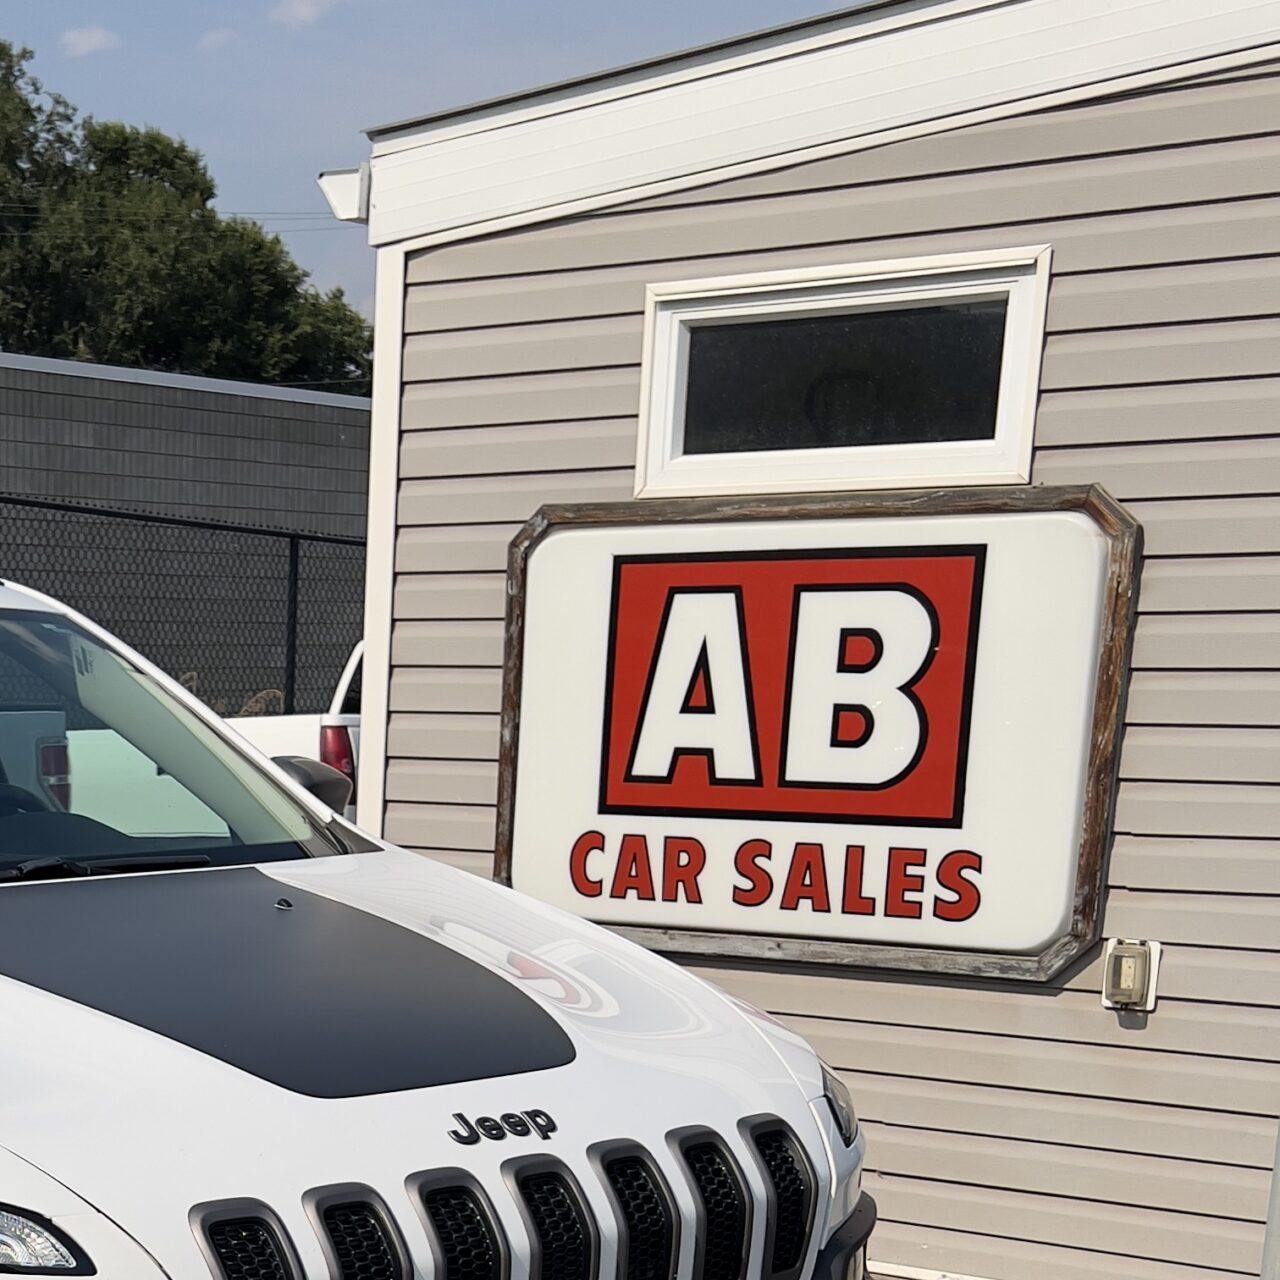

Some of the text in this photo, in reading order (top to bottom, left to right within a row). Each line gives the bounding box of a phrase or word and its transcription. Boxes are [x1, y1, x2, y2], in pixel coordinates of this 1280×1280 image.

[624, 583, 940, 790] AB
[569, 830, 983, 922] CAR SALES
[447, 1109, 558, 1146] Jeep
